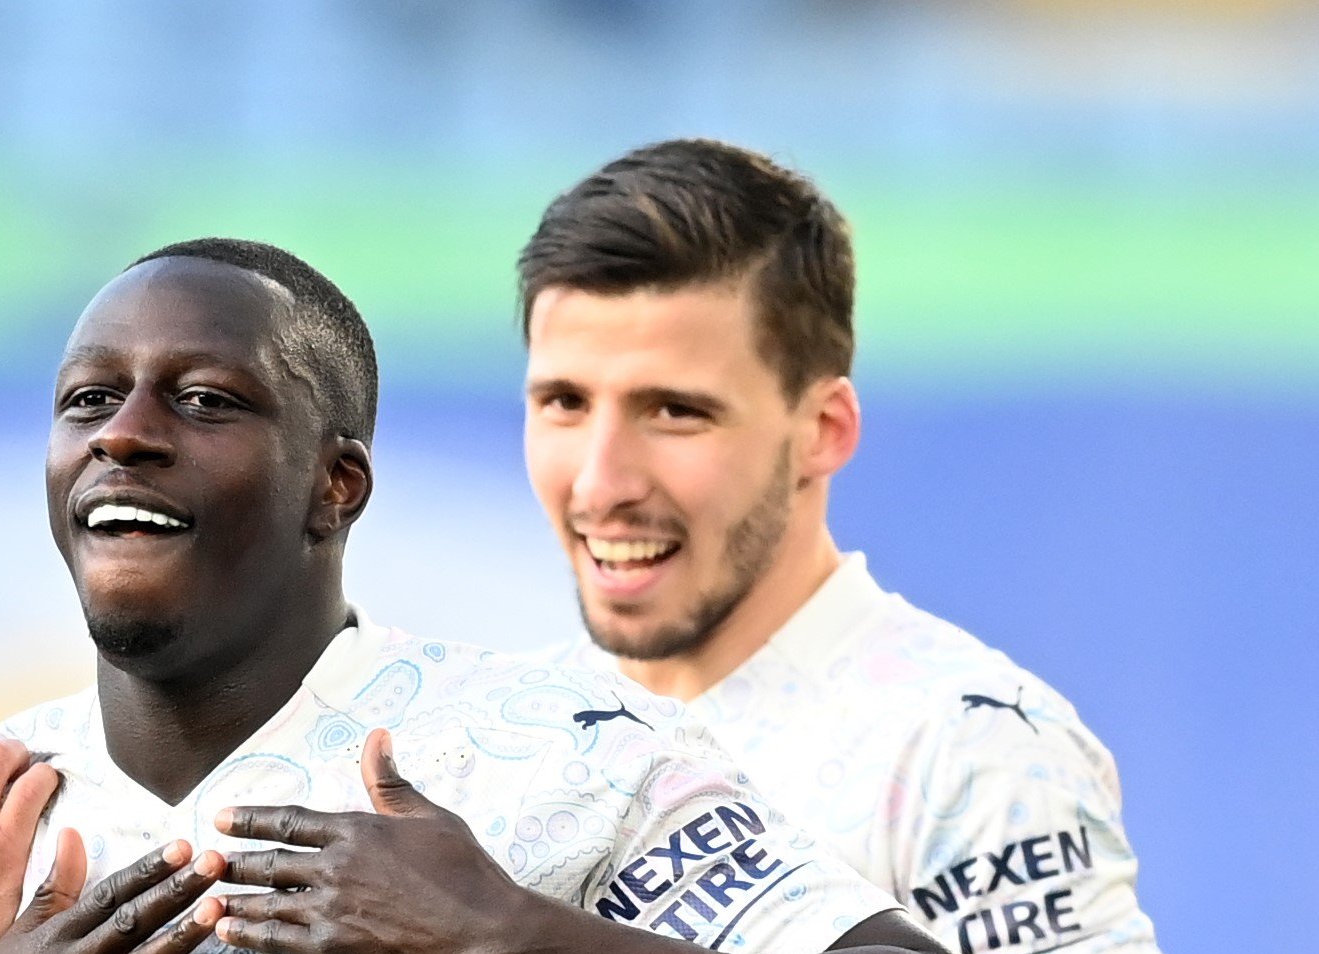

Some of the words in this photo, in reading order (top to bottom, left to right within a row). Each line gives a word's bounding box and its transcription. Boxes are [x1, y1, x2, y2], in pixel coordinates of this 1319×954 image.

[595, 801, 767, 923] NEXEN
[649, 838, 783, 942] TIRE
[912, 826, 1093, 921] NEXEN
